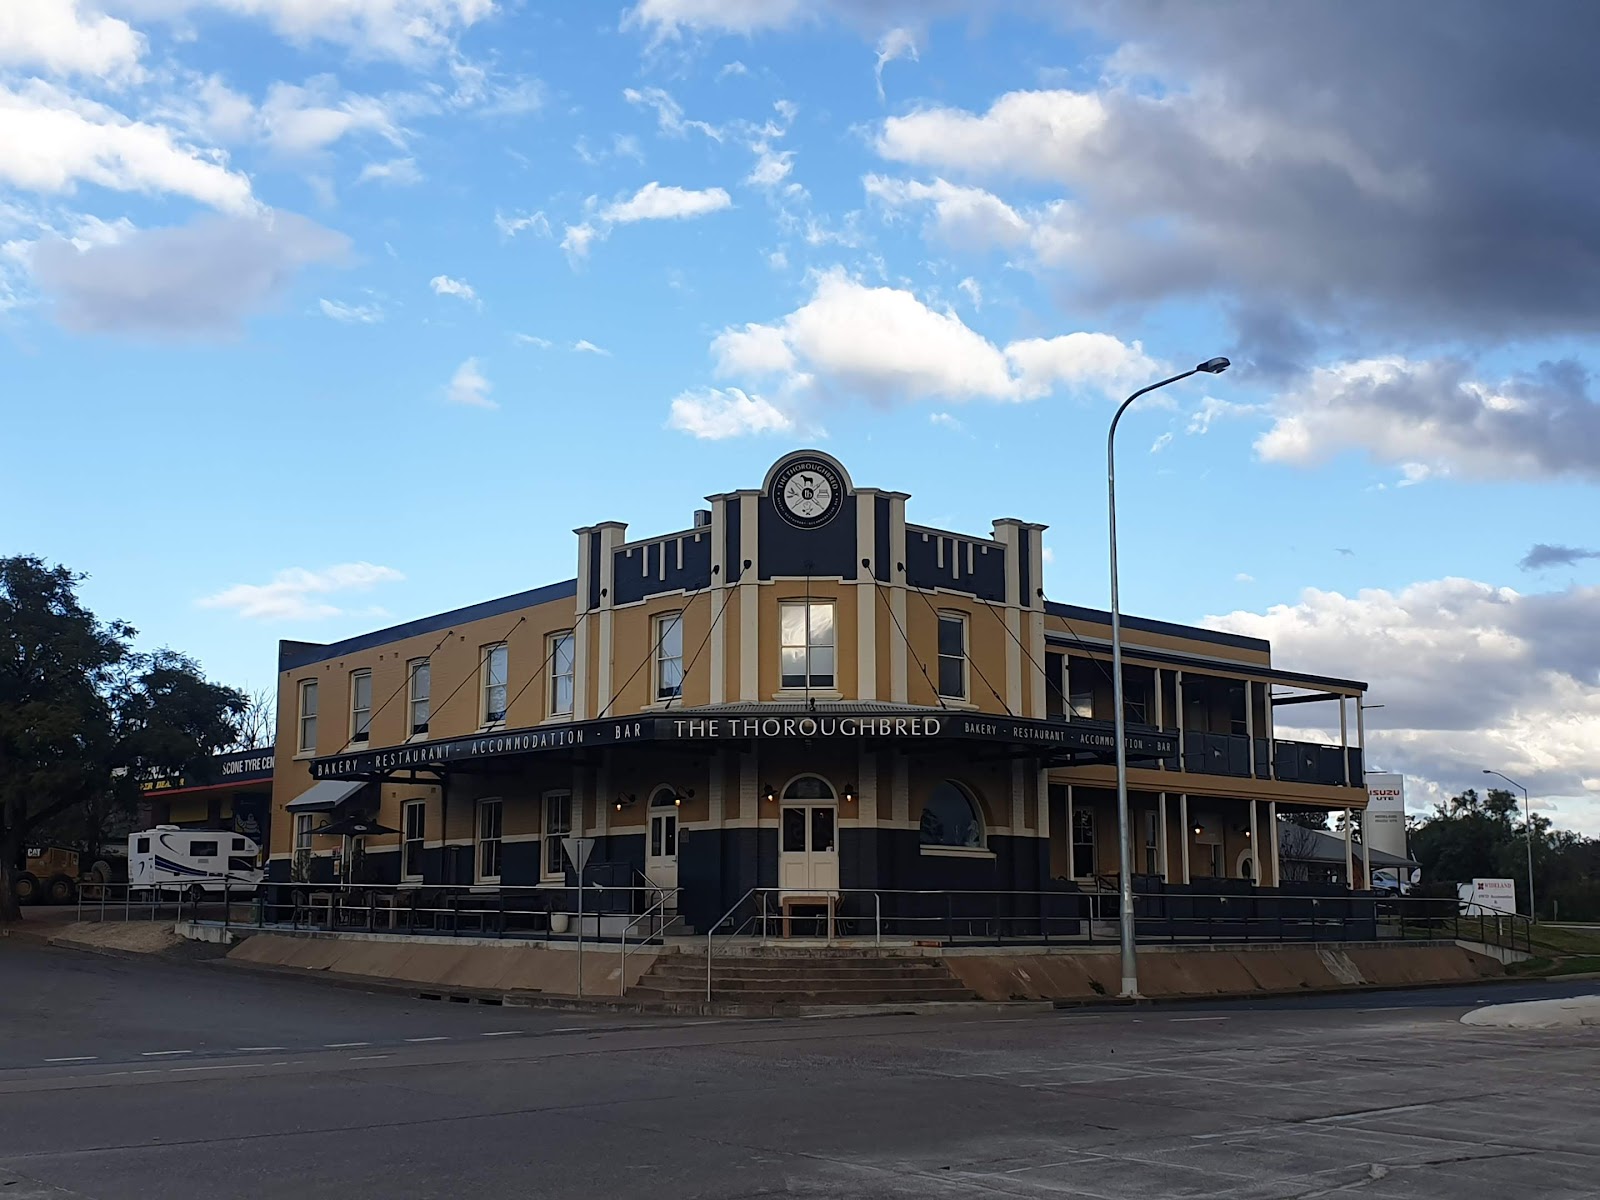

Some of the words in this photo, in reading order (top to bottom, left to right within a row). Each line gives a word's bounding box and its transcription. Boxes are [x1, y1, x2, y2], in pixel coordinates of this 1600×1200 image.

[777, 475, 786, 489] THE
[786, 463, 839, 490] THOROUGHBRED
[673, 719, 719, 738] THE
[727, 718, 941, 737] THOROUGHBRED
[964, 722, 997, 736] BAKERY
[1013, 727, 1065, 742] RESTAURANT
[1080, 734, 1143, 750] ACCOMMOTION
[1157, 742, 1171, 752] BAR
[317, 759, 358, 777] BAKERY
[375, 745, 450, 768] RESTAURANT
[471, 729, 584, 755] ACCOMMODATION
[615, 723, 641, 740] BAR
[222, 761, 244, 775] SCONE
[244, 758, 261, 772] TYRE
[27, 848, 41, 857] CAT
